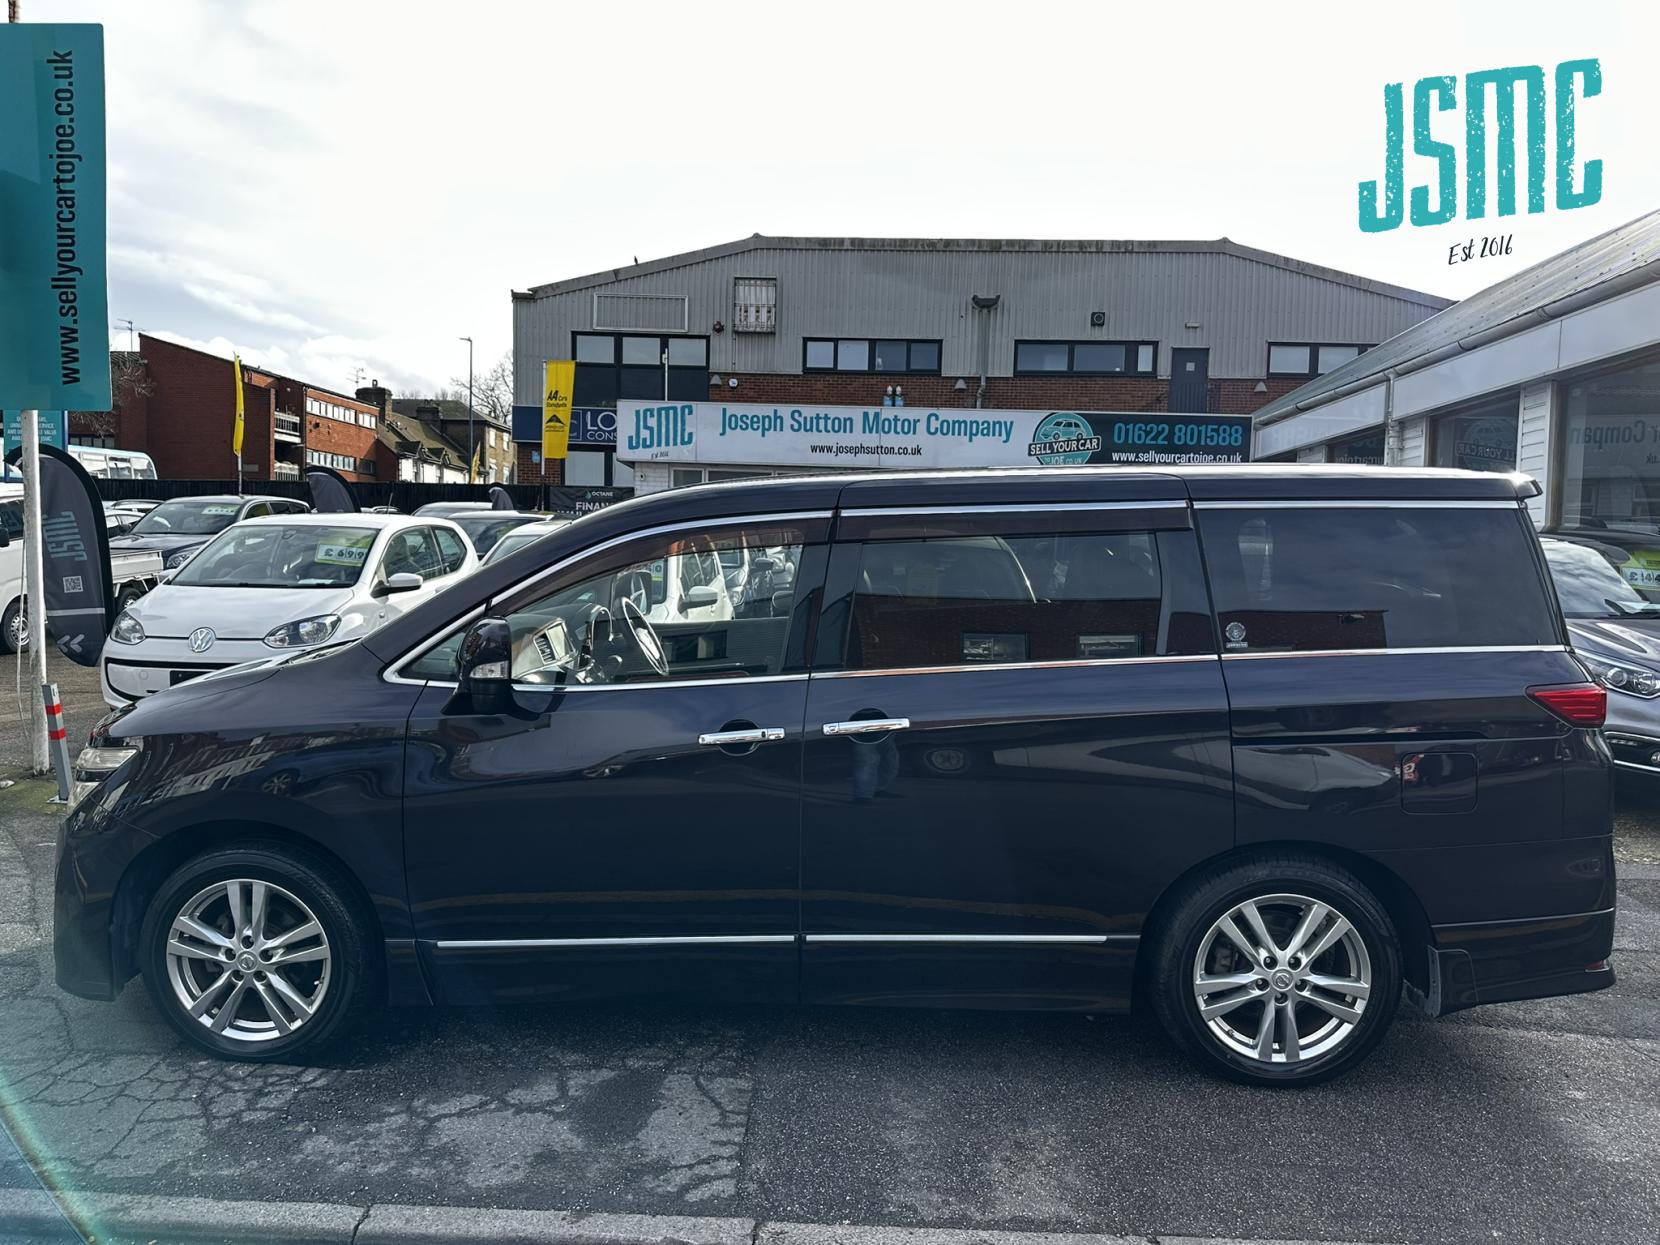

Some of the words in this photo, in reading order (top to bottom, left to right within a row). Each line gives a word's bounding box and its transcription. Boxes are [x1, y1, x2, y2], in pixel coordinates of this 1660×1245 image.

[46, 49, 83, 386] www.sellyourcartojoe.co.uk
[627, 404, 693, 450] JSMC
[719, 407, 784, 437] Joseph
[790, 410, 853, 433] Sutton
[862, 411, 920, 435] Motor
[926, 413, 1014, 443] Company
[1113, 423, 1169, 445] 01622
[1174, 424, 1242, 446] 801588
[811, 443, 922, 457] www.josephsutton.co.uk
[1030, 443, 1051, 455] SELL
[1052, 440, 1077, 453] YOUR
[1078, 439, 1098, 450] CAR
[42, 511, 87, 561] JSMC
